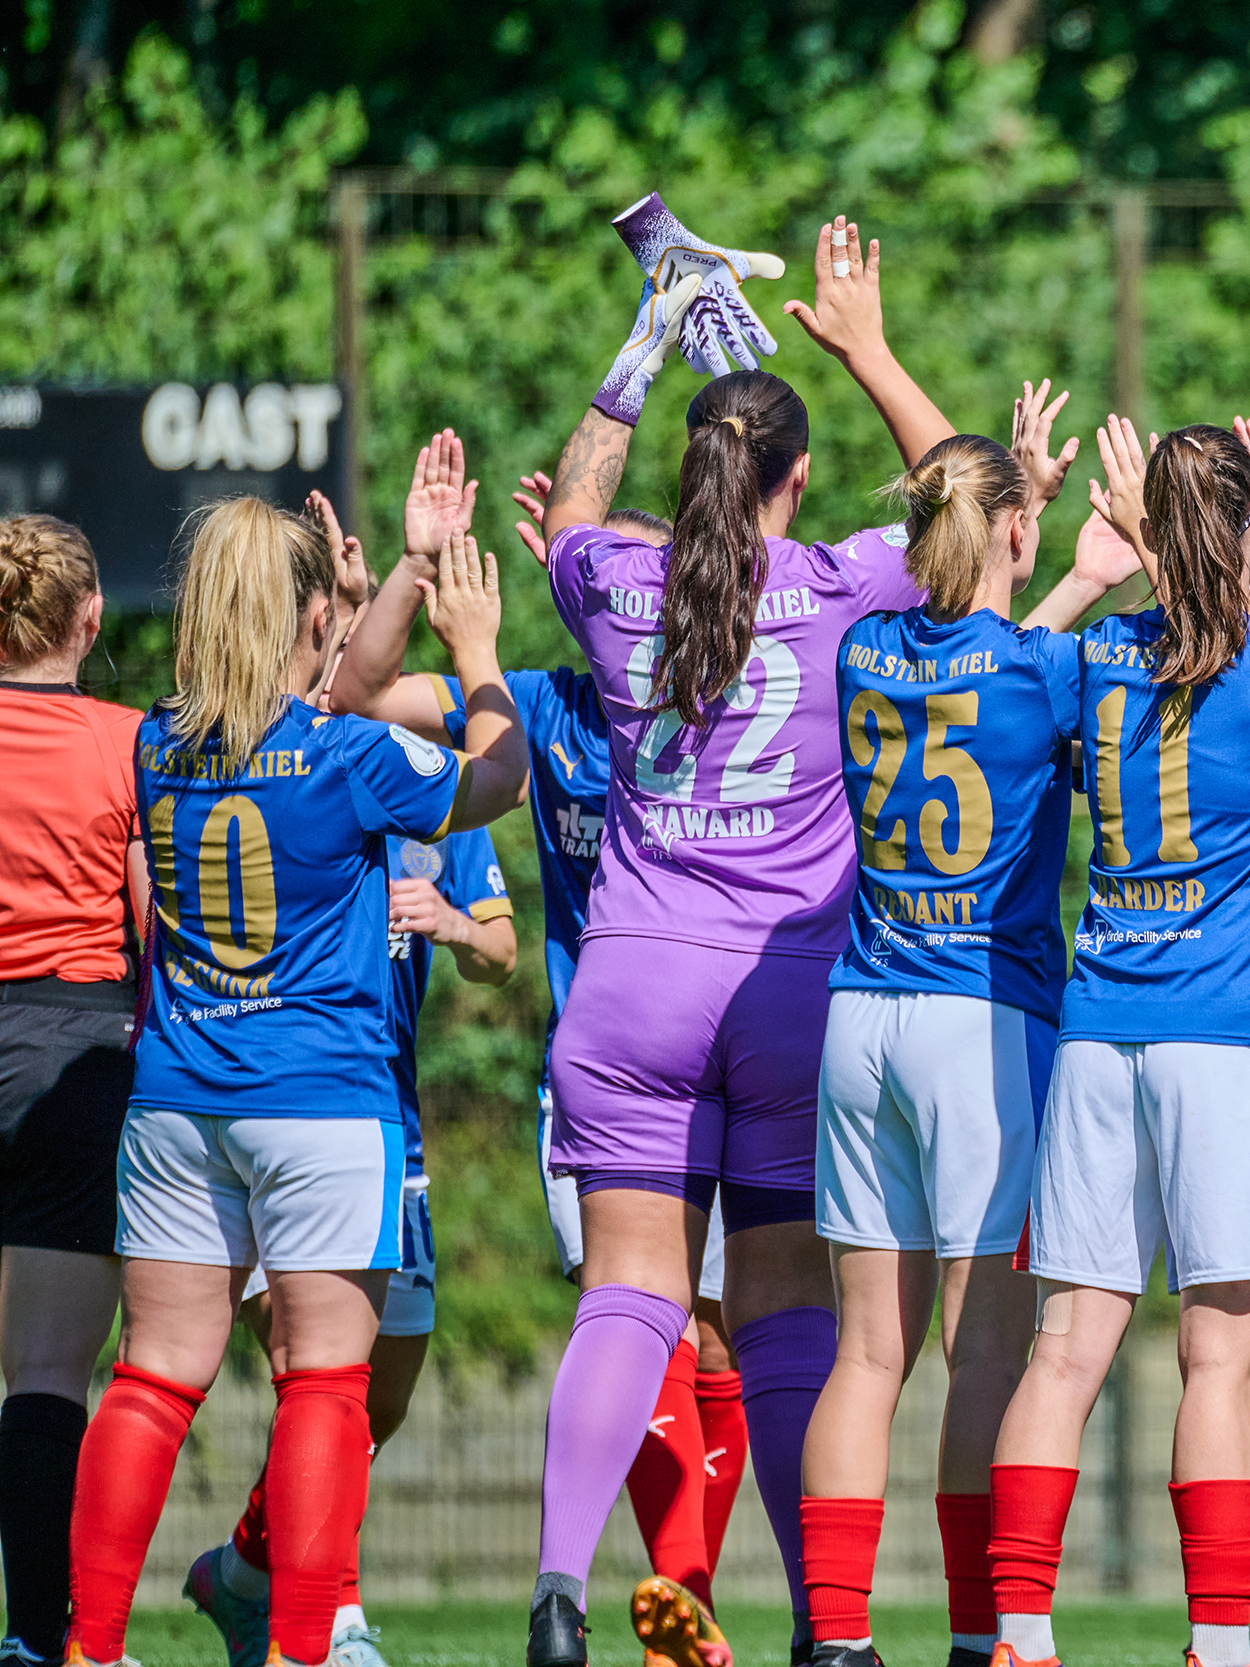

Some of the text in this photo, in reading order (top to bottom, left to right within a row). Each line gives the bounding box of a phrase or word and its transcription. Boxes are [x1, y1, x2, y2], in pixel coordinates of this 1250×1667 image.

[141, 382, 343, 471] GAST
[755, 587, 820, 622] KIEL
[846, 643, 999, 683] HOLSTEIN KIEL
[1084, 640, 1165, 670] HOLSTE
[626, 635, 801, 803] 22
[139, 741, 311, 781] OLSTEIN KIEL
[1096, 685, 1199, 867] 11
[846, 689, 994, 876] 25
[148, 794, 278, 970] 10
[1091, 873, 1206, 912] HARDER
[1126, 931, 1162, 945] Facility
[1161, 928, 1202, 941] Service
[203, 1003, 238, 1020] Facility
[240, 996, 282, 1013] Service
